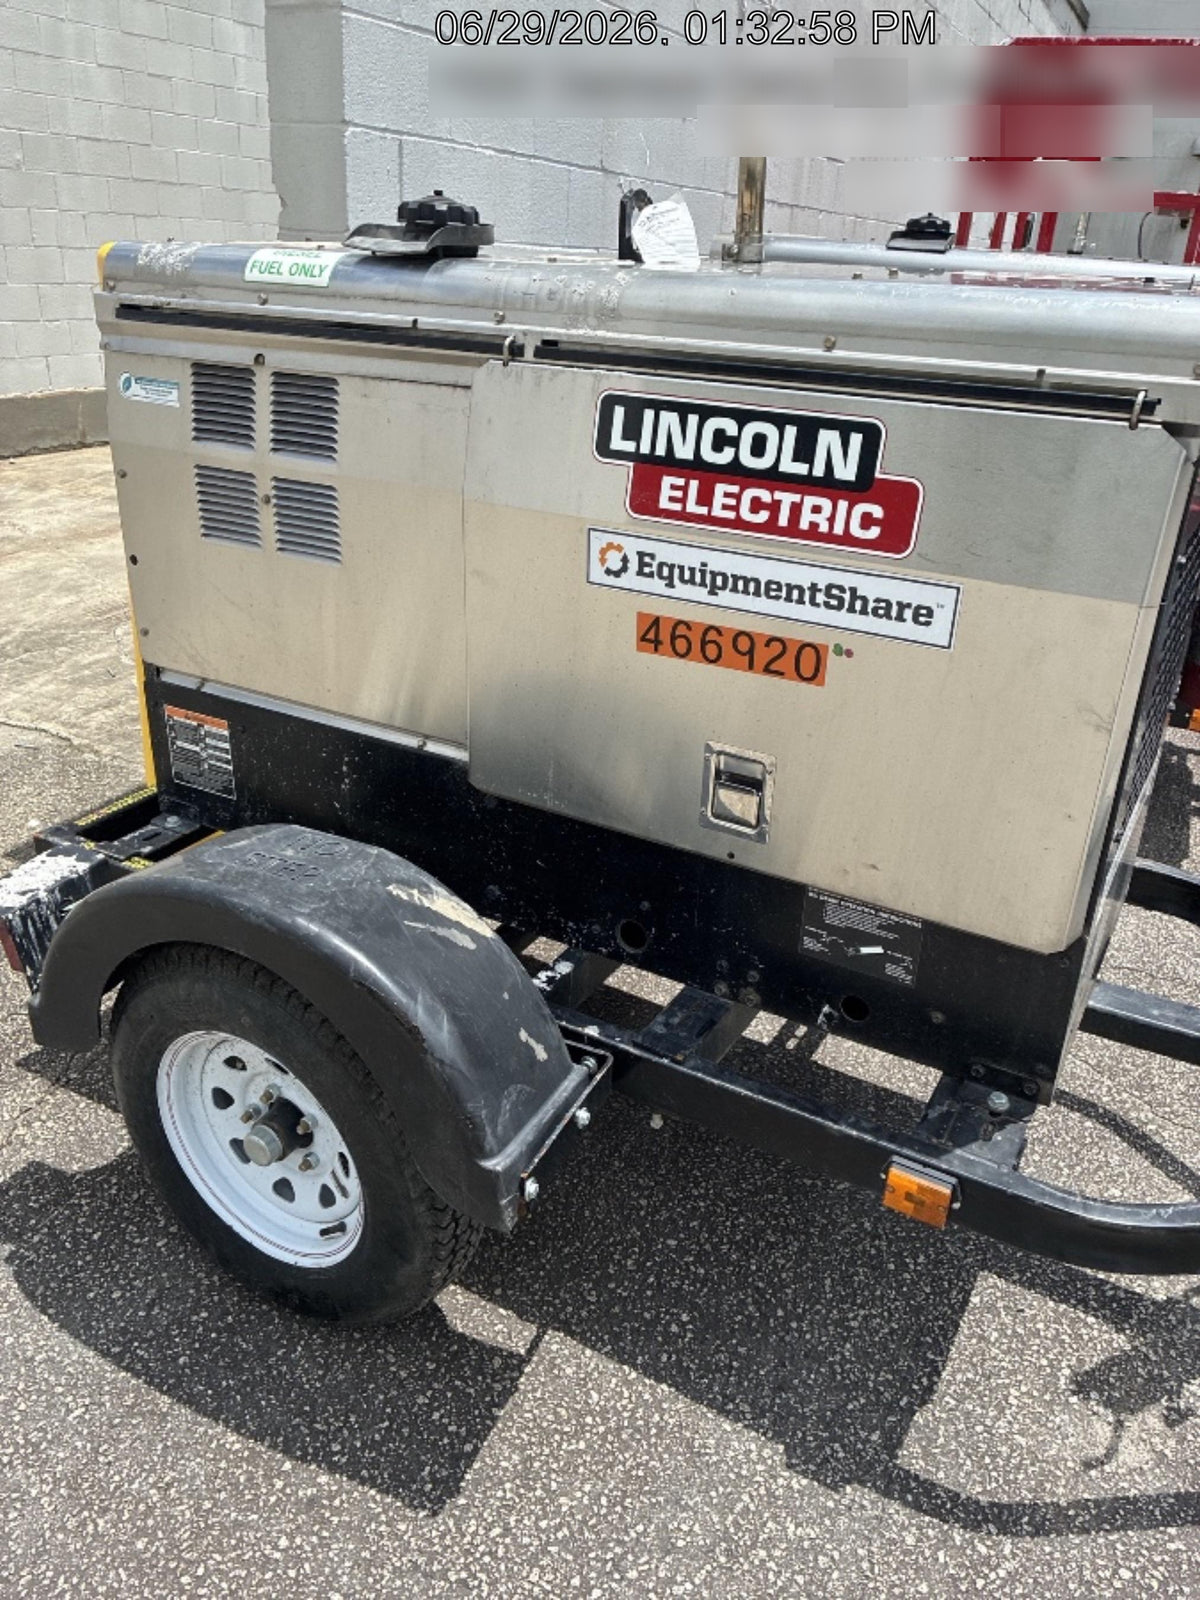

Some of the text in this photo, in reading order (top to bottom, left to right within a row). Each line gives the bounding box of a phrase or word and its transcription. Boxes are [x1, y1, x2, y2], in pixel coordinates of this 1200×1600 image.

[250, 260, 329, 278] FUEL ONLY
[609, 405, 863, 482] LINCOLN
[658, 475, 885, 540] ELECTRIC
[635, 550, 935, 627] EquipmentShare
[639, 616, 823, 683] 466920
